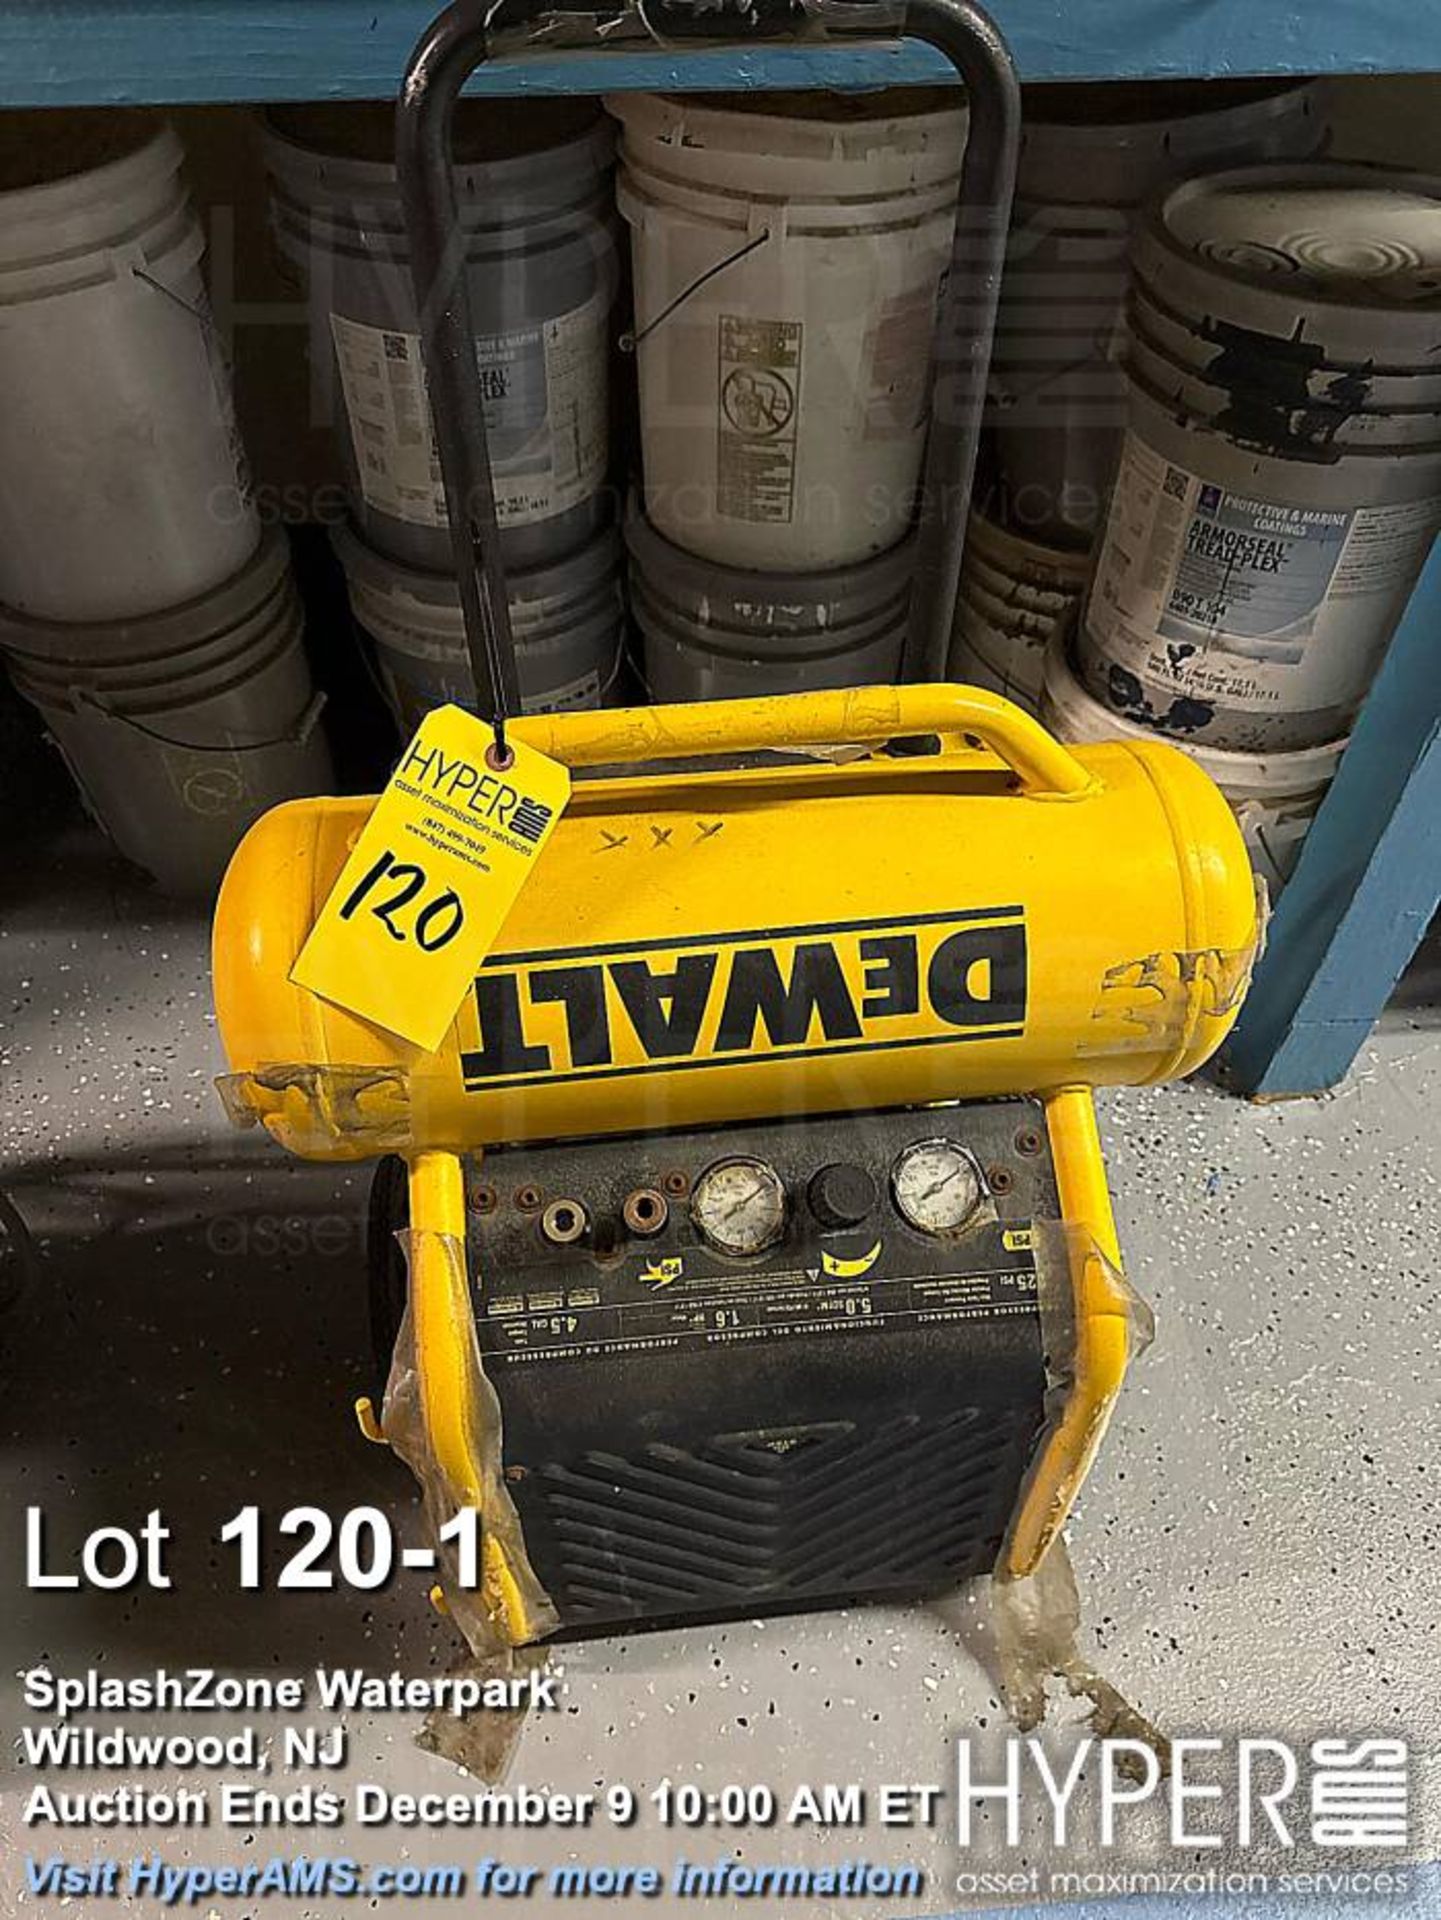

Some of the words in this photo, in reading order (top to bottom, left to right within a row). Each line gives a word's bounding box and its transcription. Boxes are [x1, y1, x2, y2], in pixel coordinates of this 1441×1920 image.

[1224, 495, 1289, 521] PROTECTIVE
[1300, 511, 1347, 527] MARINE
[1253, 516, 1308, 536] COATINGS
[401, 738, 518, 826] HYPER
[394, 779, 423, 798] asset
[421, 793, 491, 835] maximization
[490, 830, 533, 857] services
[338, 849, 465, 953] 120
[459, 922, 1028, 1078] DEWALT
[1011, 1233, 1031, 1247] PSI
[846, 1297, 872, 1315] 5.0
[530, 1318, 549, 1330] GAL
[550, 1316, 578, 1335] 4.5
[714, 1309, 741, 1329] 1.6
